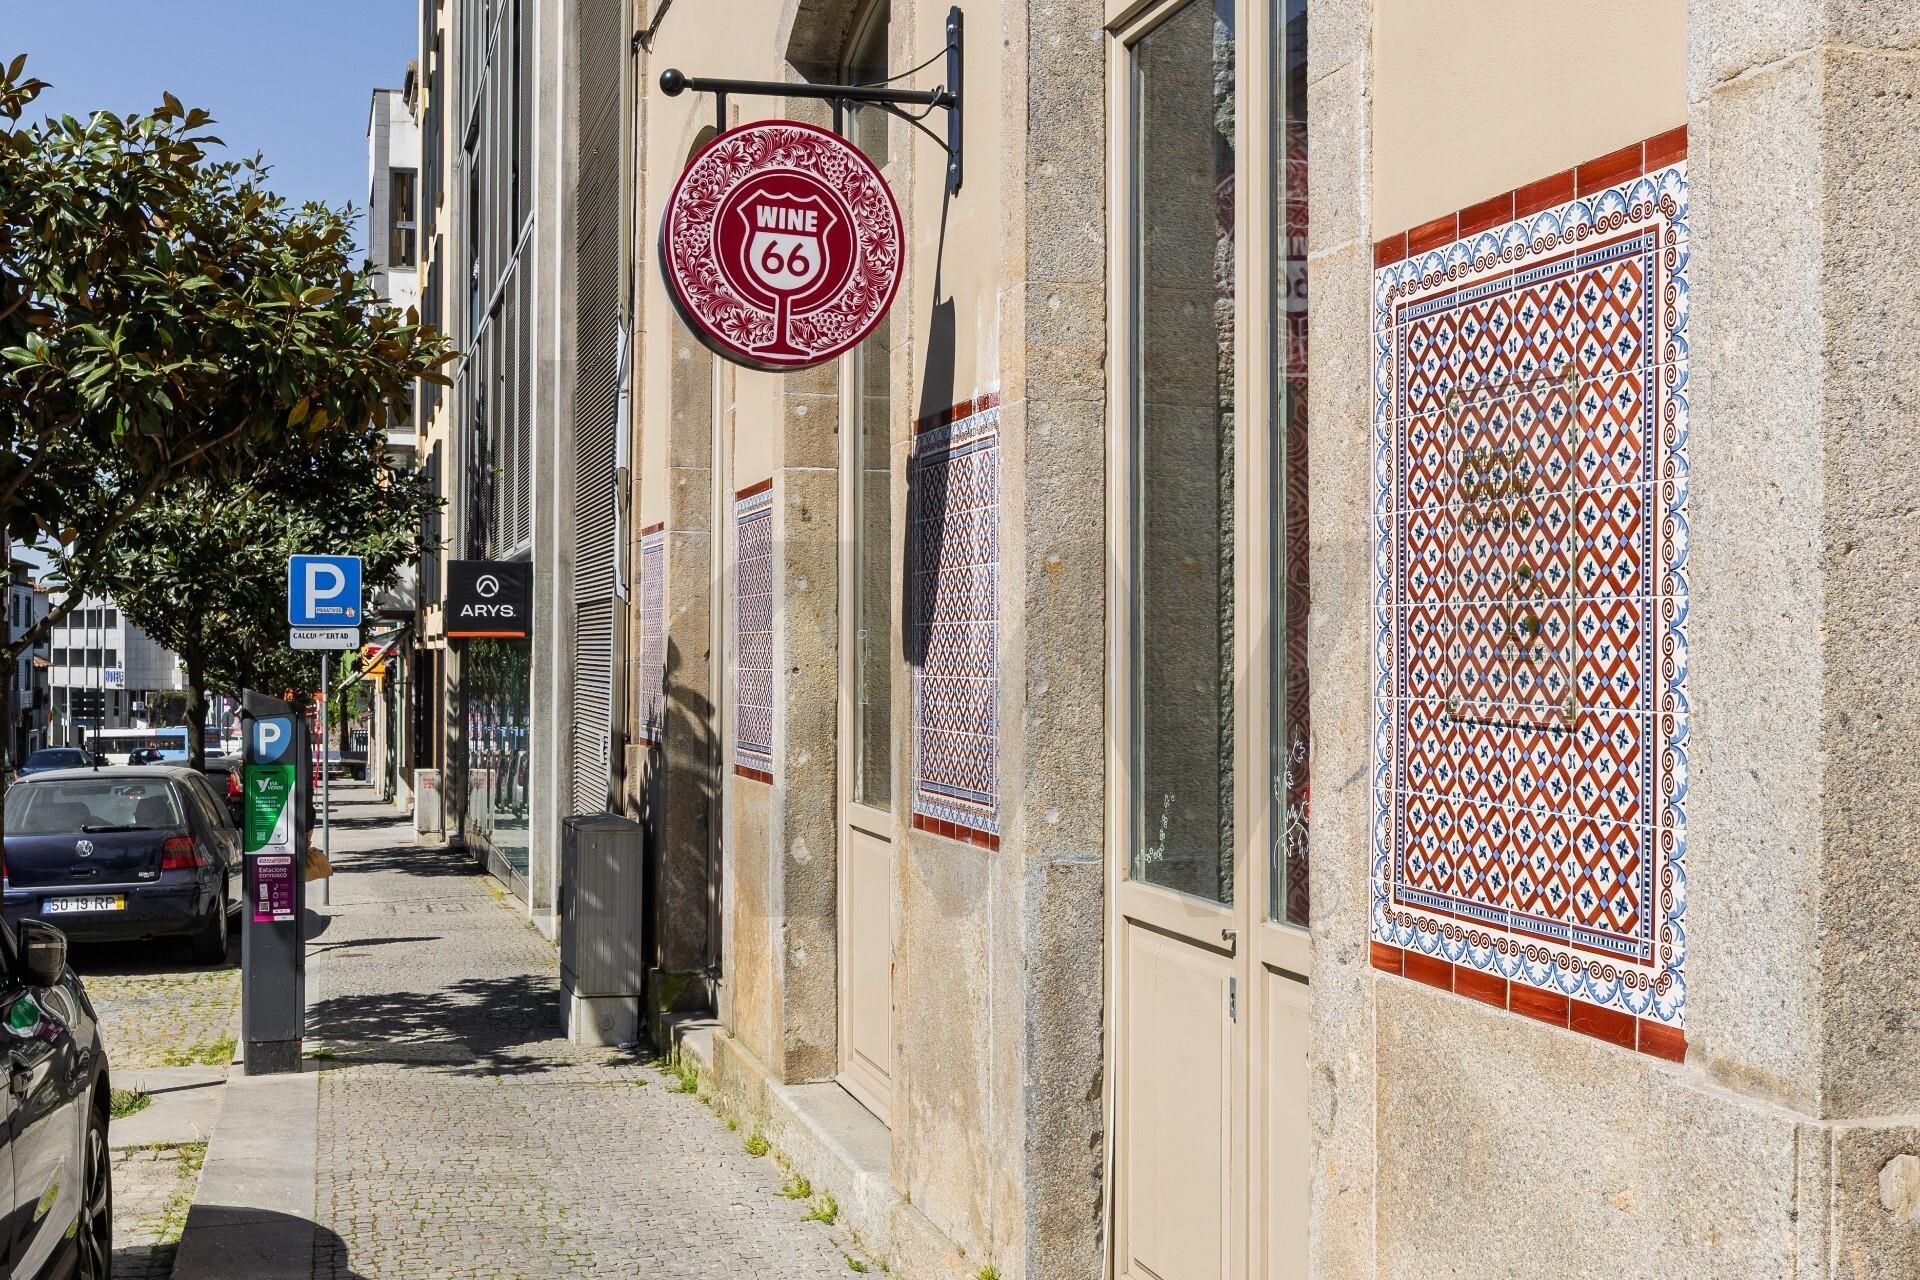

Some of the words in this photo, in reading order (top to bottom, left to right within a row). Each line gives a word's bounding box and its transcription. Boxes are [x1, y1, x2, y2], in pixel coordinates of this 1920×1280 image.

[756, 204, 818, 233] WINE
[761, 239, 810, 277] 66
[305, 562, 346, 619] P
[259, 722, 281, 756] P
